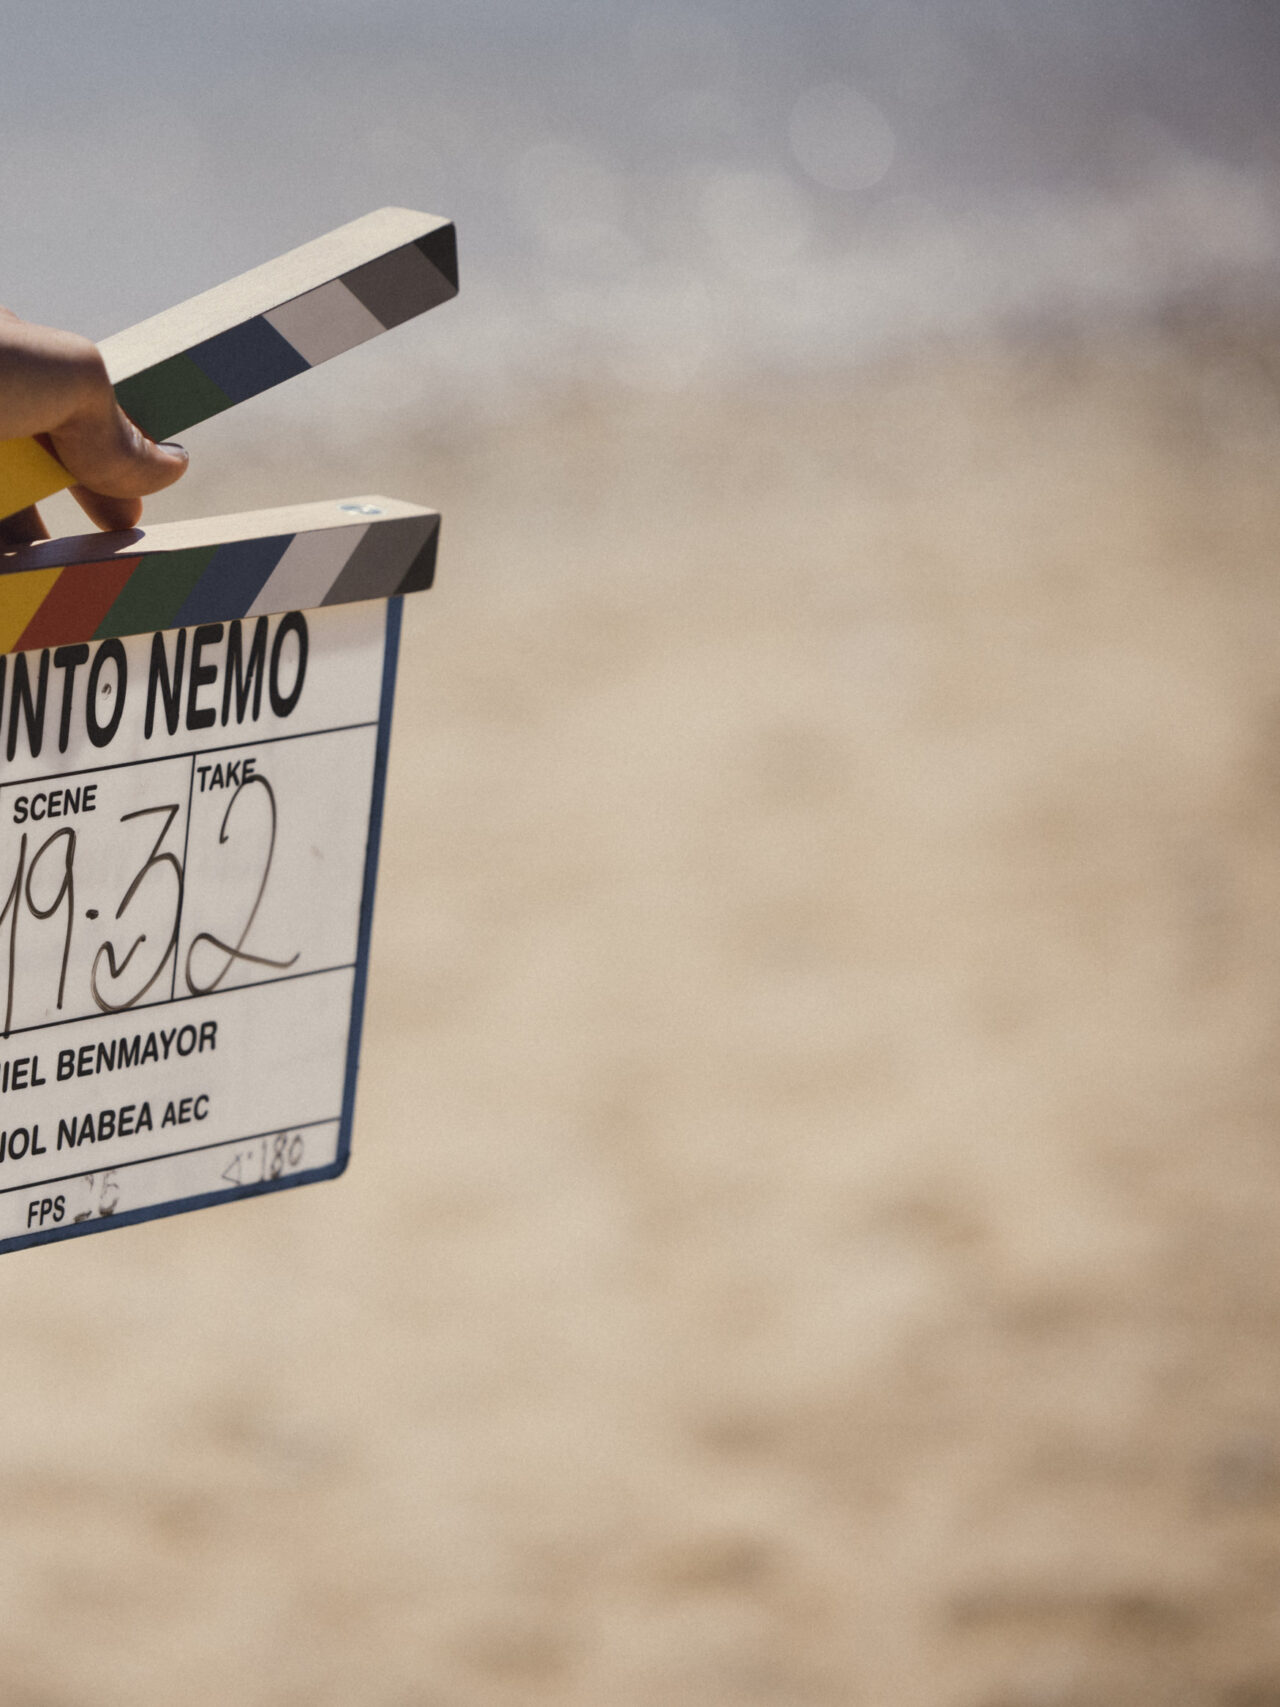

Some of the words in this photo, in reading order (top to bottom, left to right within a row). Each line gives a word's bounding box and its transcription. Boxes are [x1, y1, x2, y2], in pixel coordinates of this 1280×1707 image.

[144, 610, 309, 740] NEMO
[196, 758, 257, 792] TAKE
[12, 784, 98, 824] SCENE
[185, 774, 301, 996] 2
[56, 1020, 218, 1082] BENMAYOR
[57, 1100, 153, 1151] NABEA
[161, 1094, 210, 1129] AEC
[27, 1195, 66, 1229] FPS
